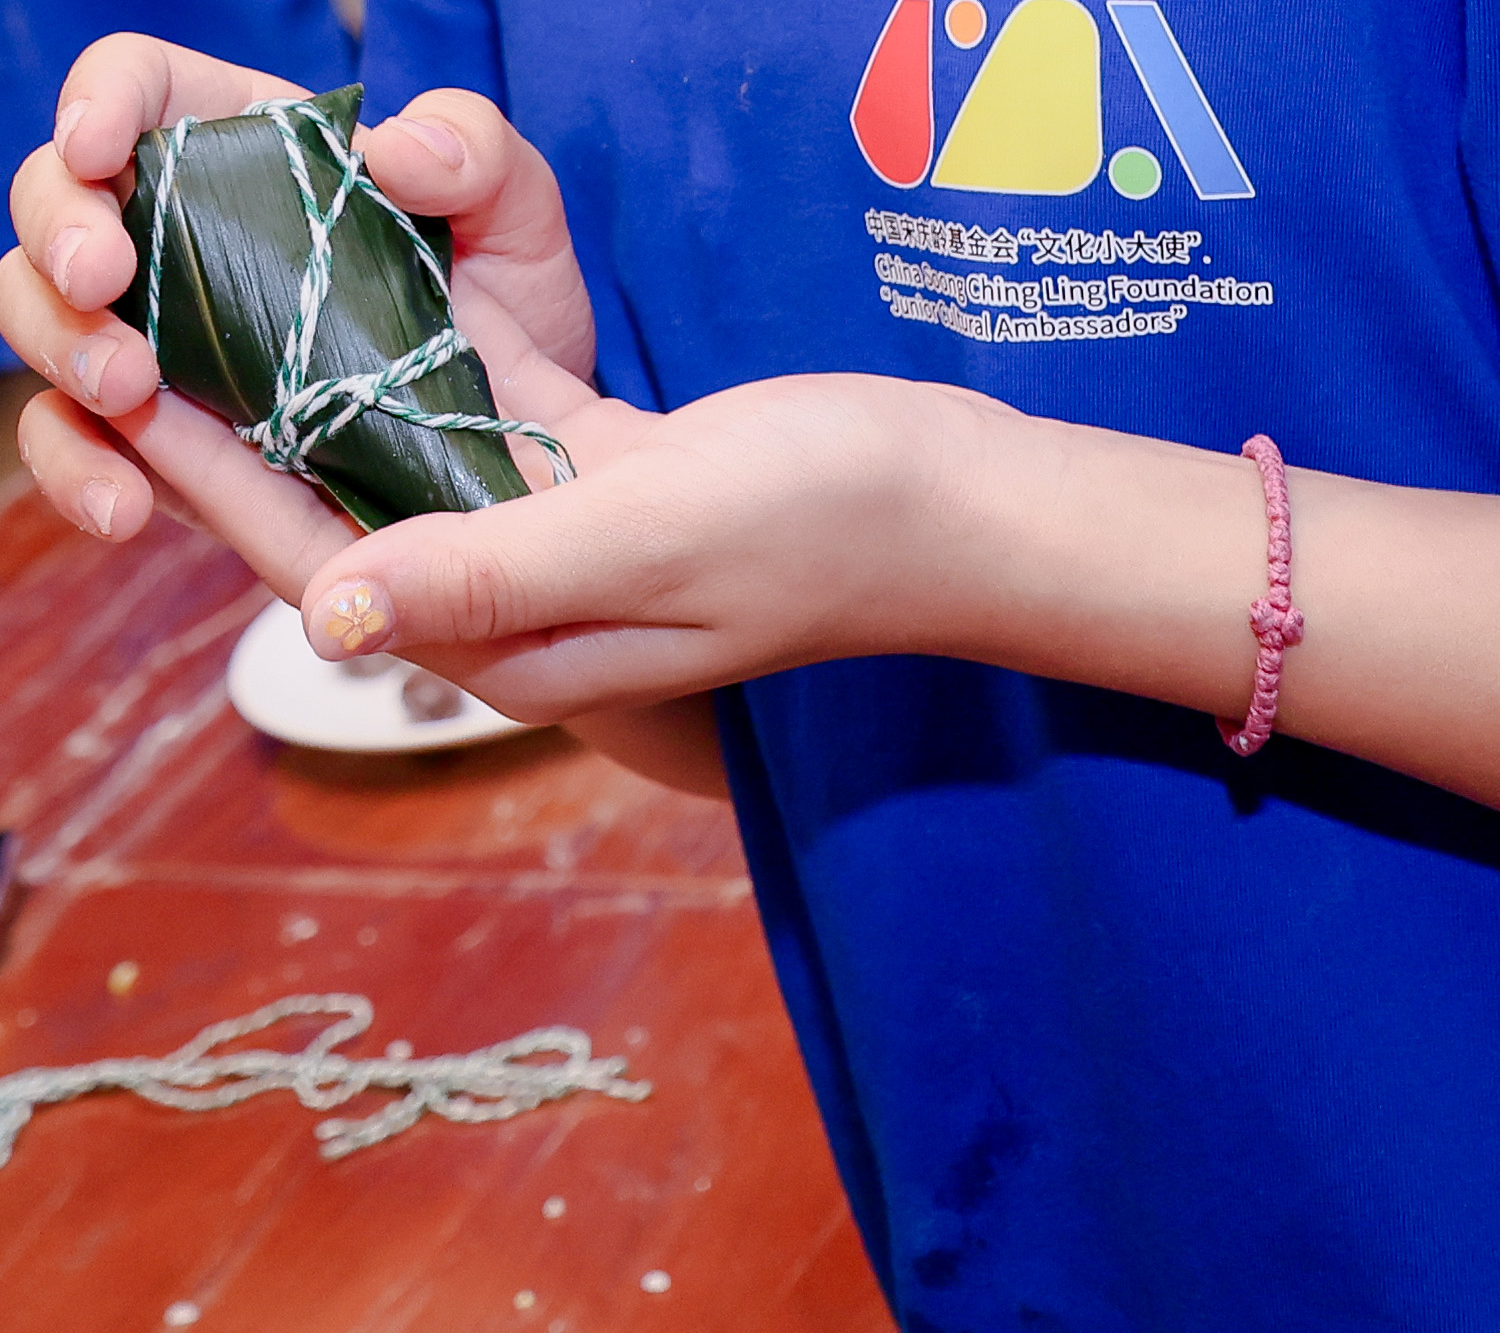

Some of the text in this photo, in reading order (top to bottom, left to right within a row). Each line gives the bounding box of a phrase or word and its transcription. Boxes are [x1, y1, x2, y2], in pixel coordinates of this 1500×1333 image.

[875, 253, 1273, 312] China Soong Ching Ling Foundation
[994, 304, 1187, 342] Ambassadors”
